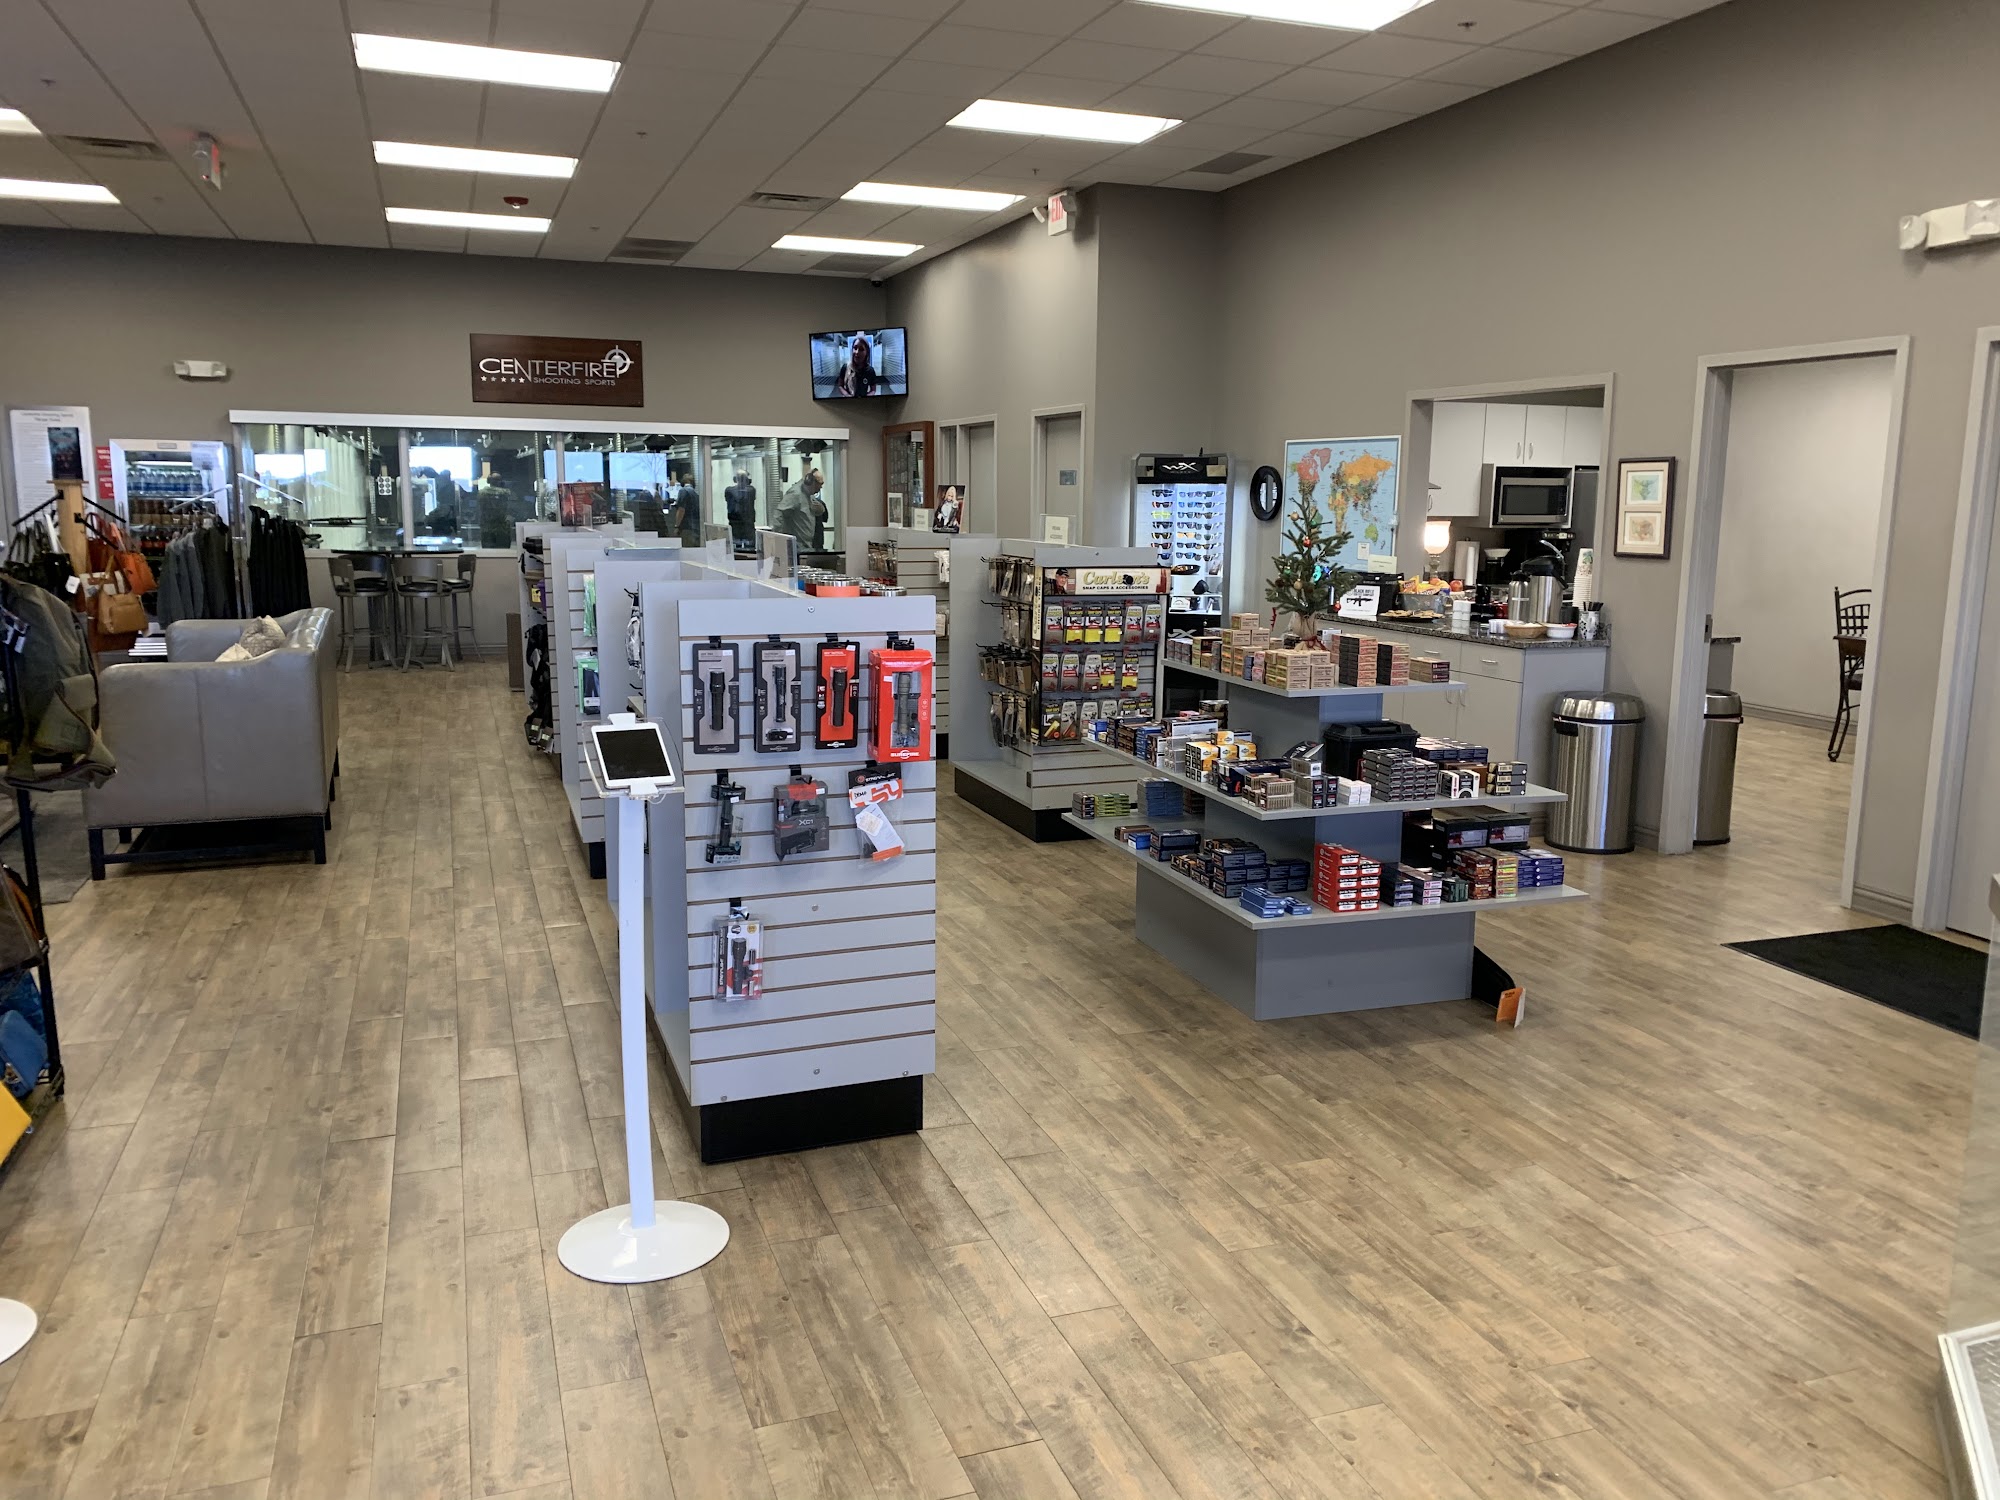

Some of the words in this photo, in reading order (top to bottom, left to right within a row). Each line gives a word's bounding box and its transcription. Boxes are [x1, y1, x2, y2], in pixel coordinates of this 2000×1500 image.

[479, 358, 616, 382] CENTERFIRE
[533, 377, 581, 385] SHOOTING
[1083, 571, 1150, 586] Carlson's
